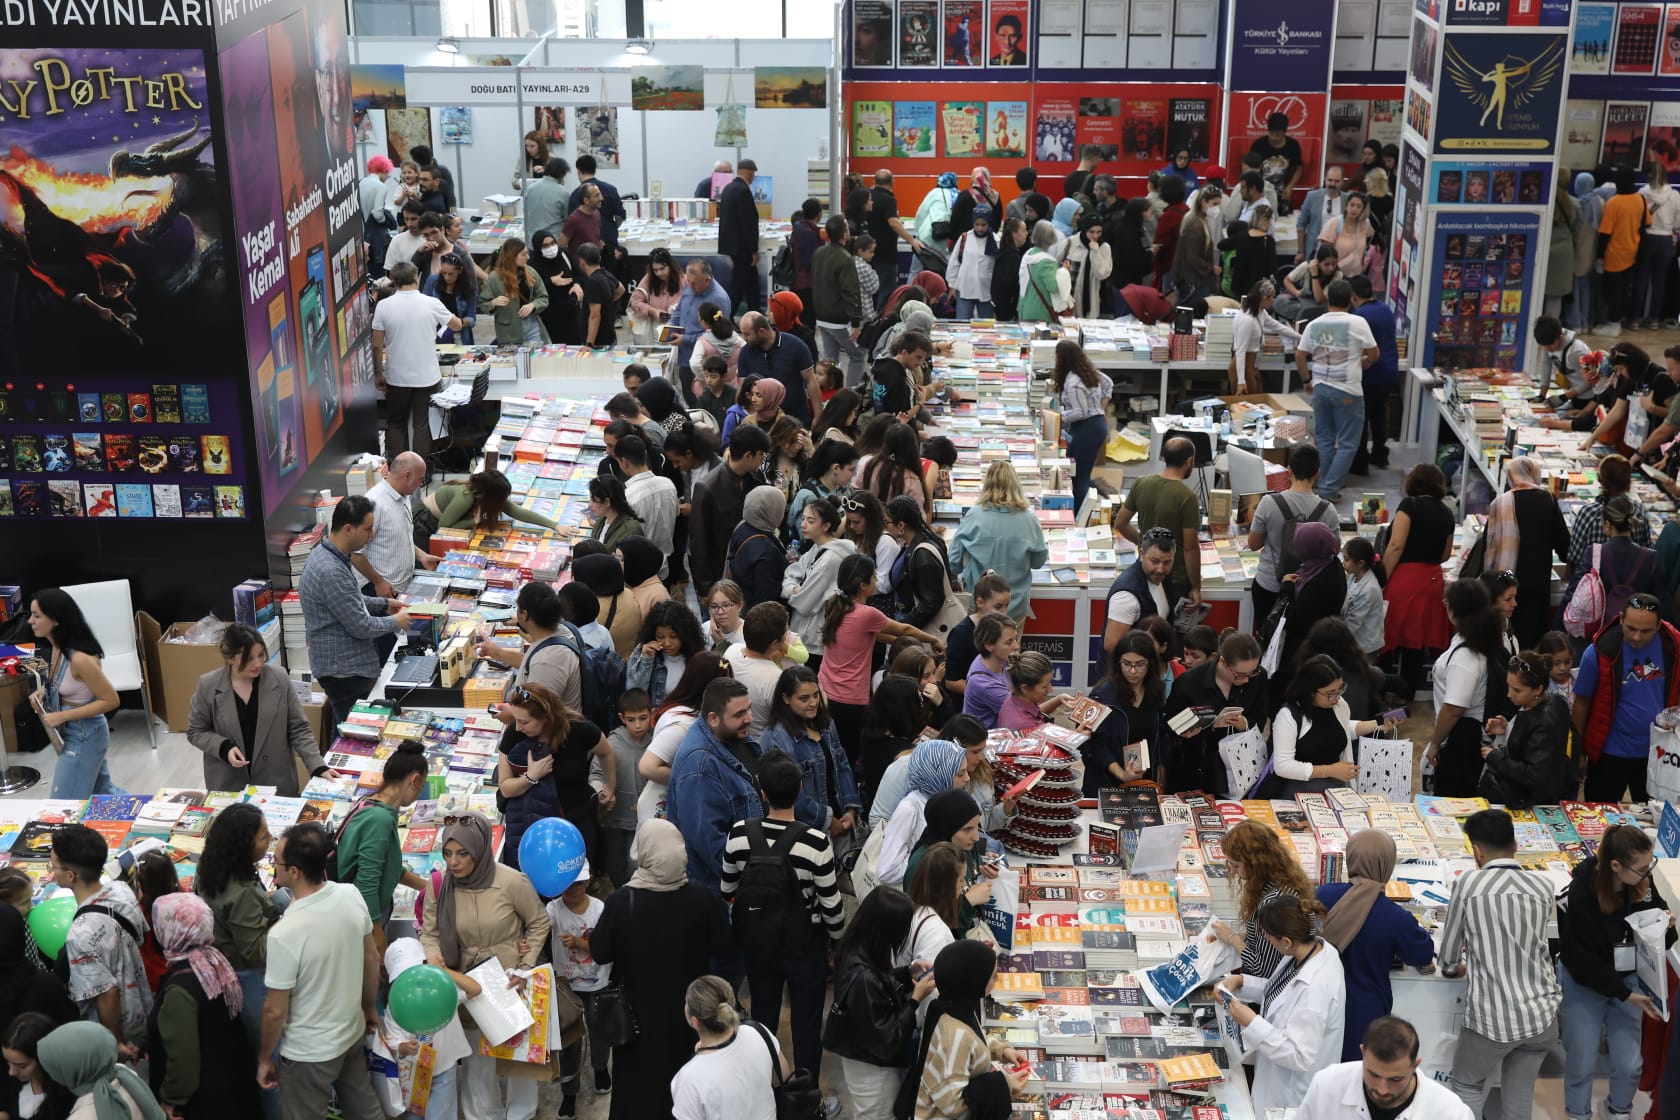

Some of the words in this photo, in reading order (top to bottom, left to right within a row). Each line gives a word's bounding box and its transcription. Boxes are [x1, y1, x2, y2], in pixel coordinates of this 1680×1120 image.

[43, 0, 213, 26] YAYINLARI
[1621, 12, 1645, 20] 1984
[1244, 29, 1276, 38] TÜRKİYE
[1278, 48, 1308, 56] Yayınları
[33, 58, 203, 116] POTTER
[471, 84, 495, 94] DOĞU
[497, 85, 516, 94] BATI
[523, 84, 590, 94] YAYINLARI-A29
[1174, 113, 1206, 122] NUTUK
[1175, 103, 1205, 111] ATATÜRK
[325, 157, 355, 200] Orhan
[286, 184, 323, 231] Sabahattin
[328, 182, 360, 235] Pamuk
[242, 219, 275, 268] Yaşar
[290, 226, 300, 260] Ali
[248, 242, 285, 304] Kemal
